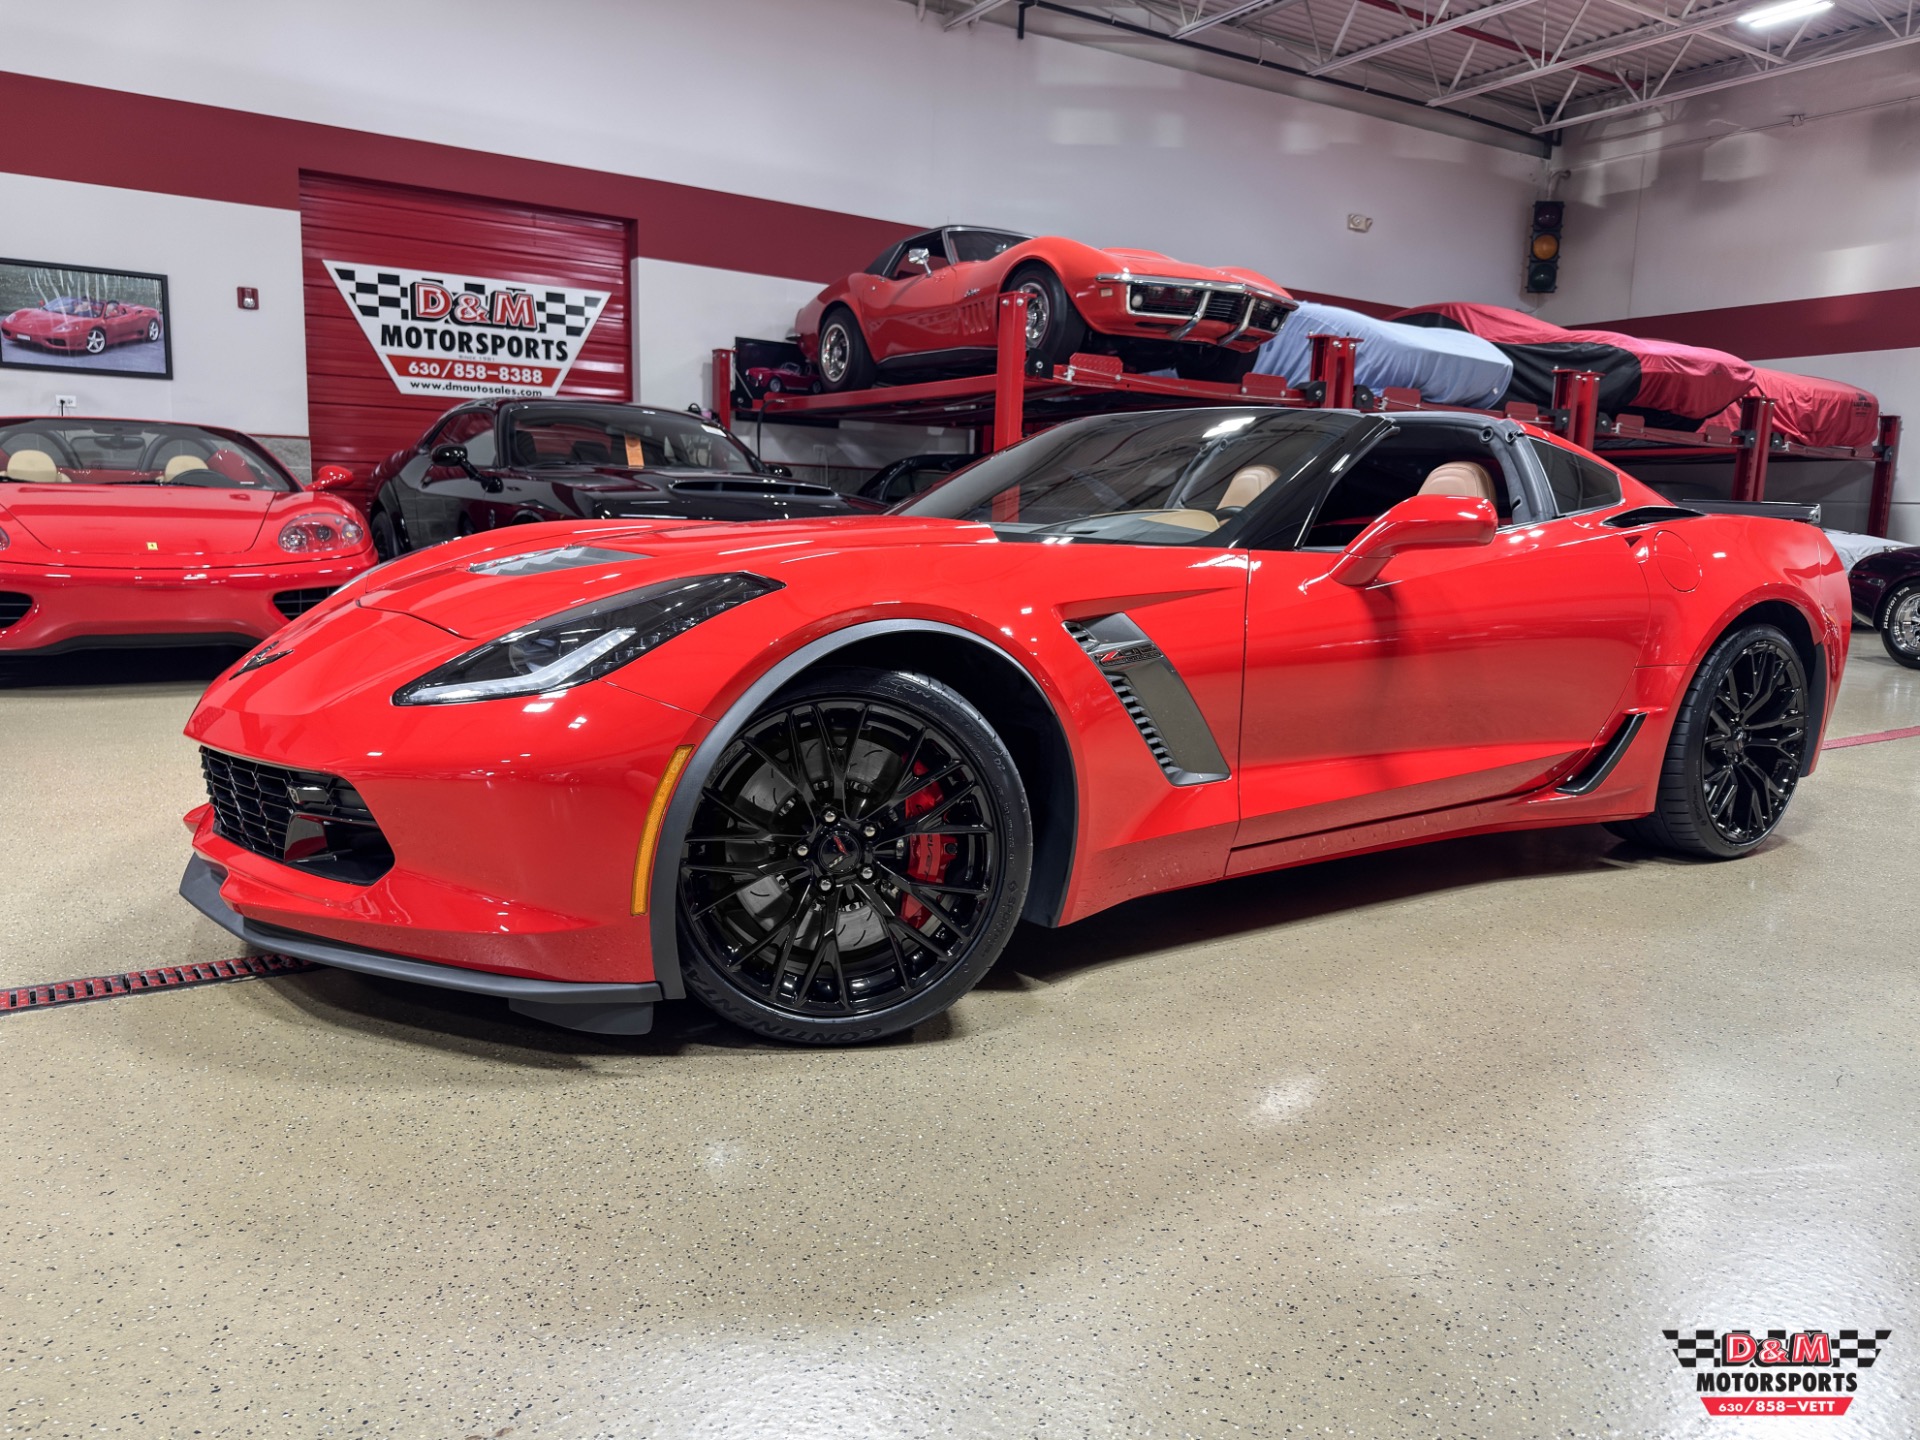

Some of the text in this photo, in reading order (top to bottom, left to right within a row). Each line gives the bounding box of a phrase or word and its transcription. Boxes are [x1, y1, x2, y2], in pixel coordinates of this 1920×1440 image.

[411, 281, 537, 331] D&M
[380, 324, 569, 362] MOTORSPORTS
[408, 361, 543, 384] 630/858-8388
[410, 380, 542, 397] www.dmautosales.com
[685, 964, 882, 1042] CONTINENTA
